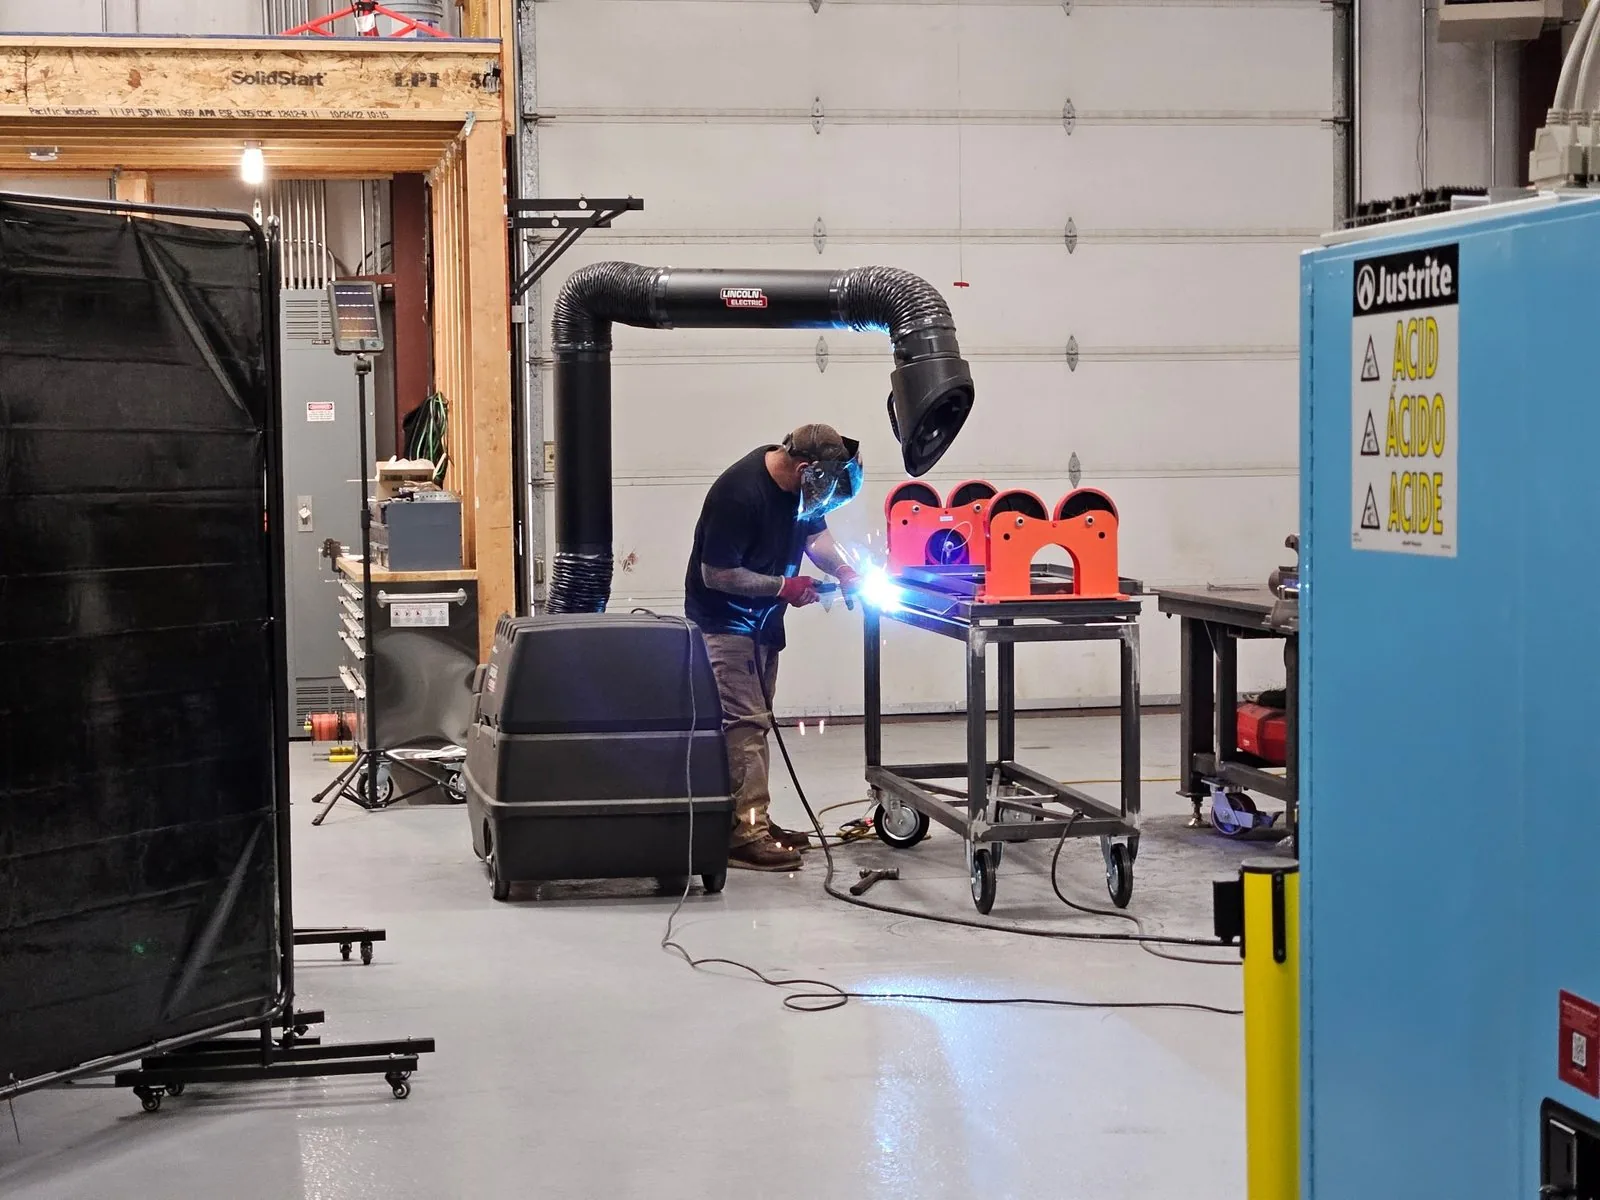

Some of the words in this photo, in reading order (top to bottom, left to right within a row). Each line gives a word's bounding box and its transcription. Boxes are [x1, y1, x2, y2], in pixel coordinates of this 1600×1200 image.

[231, 70, 324, 87] SolidStart
[394, 72, 440, 88] LPI
[28, 107, 61, 116] Pacific
[154, 108, 174, 117] MILL
[199, 109, 216, 117] APA
[366, 110, 389, 119] 10:15
[722, 290, 759, 299] LINCOLN
[1376, 256, 1452, 305] Justrite
[1392, 316, 1439, 381] ACID
[1385, 384, 1446, 458] ÁCIDO
[1387, 471, 1444, 535] ACIDE
